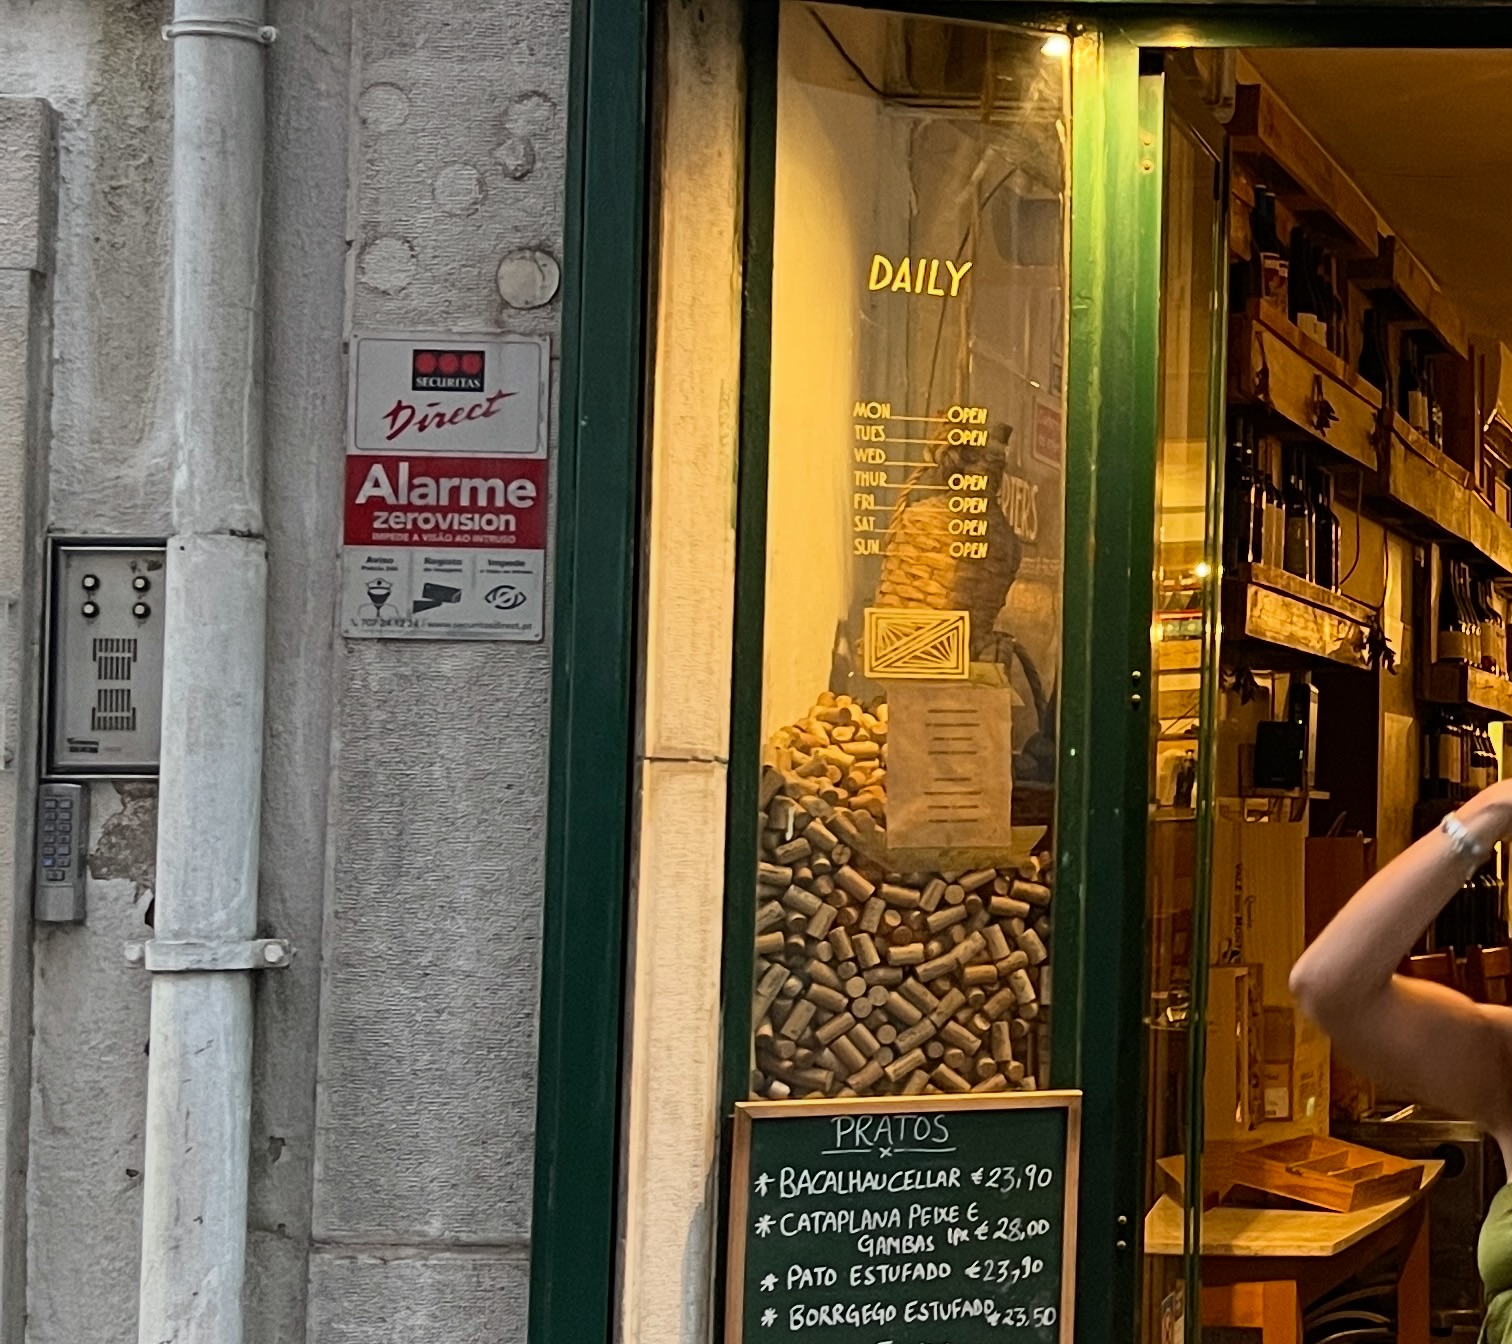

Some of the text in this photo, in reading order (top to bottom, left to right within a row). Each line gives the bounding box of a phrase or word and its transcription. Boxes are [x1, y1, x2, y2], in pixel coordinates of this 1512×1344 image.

[868, 253, 974, 298] DAILY
[415, 376, 481, 389] SECURITAS
[383, 390, 519, 441] Direct
[853, 402, 988, 424] MON OPEN
[853, 425, 988, 446] TUES OPEN
[853, 448, 886, 464] WED
[355, 461, 537, 508] Alarme
[853, 470, 988, 491] THUR OPEN
[853, 493, 988, 514] FRI OPEN
[372, 512, 516, 532] zerovision
[853, 516, 988, 537] SAT OPEN
[412, 533, 420, 541] A
[455, 534, 471, 543] AO
[853, 538, 988, 559] SUN OPEN
[831, 1115, 949, 1147] PRATOS
[780, 1208, 900, 1236] CATAPLANA
[908, 1203, 959, 1229] PEIXE
[857, 1235, 935, 1257] GAMBAS
[787, 1264, 838, 1291] PATO
[850, 1262, 951, 1287] ESTUFADO
[790, 1302, 896, 1331] BORRGEGO
[904, 1298, 994, 1323] ESTUFADO
